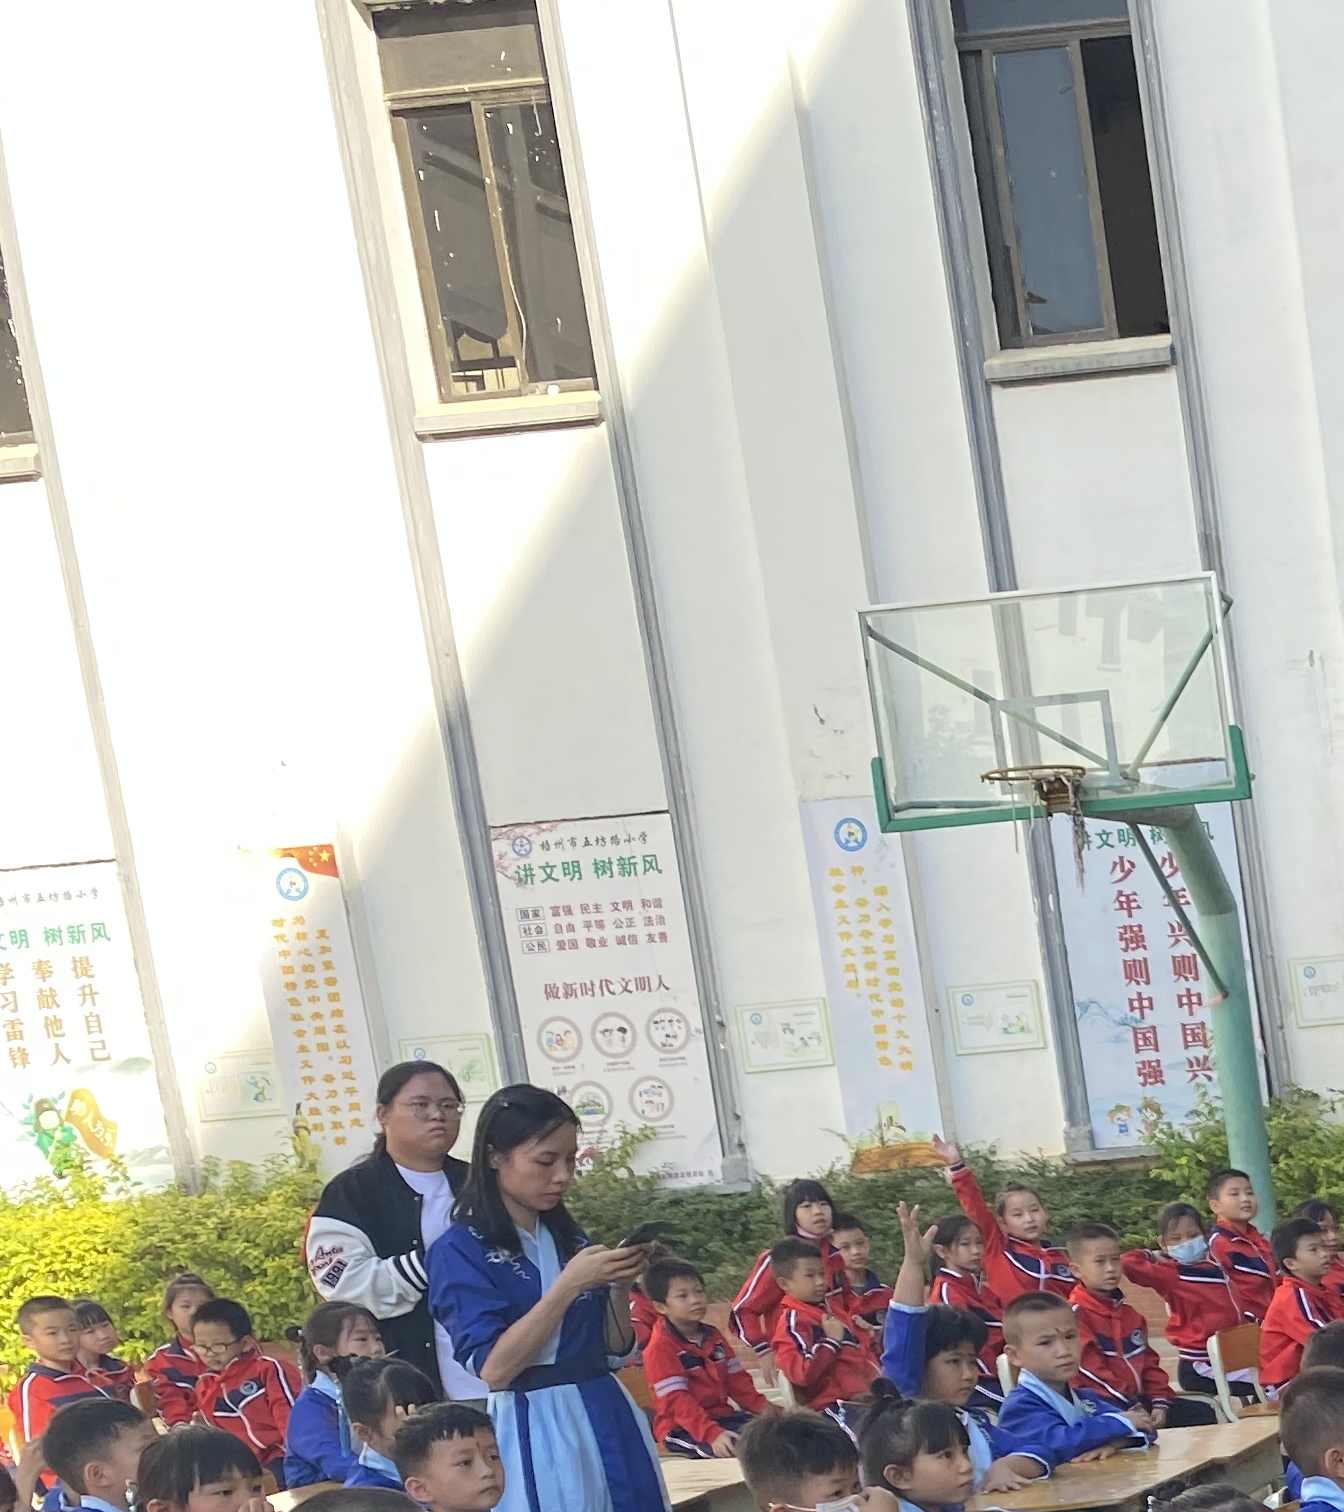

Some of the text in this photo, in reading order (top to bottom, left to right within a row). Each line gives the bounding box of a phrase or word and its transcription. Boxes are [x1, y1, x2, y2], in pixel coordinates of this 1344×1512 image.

[514, 854, 663, 886] 讲文明 树新风
[580, 903, 603, 915] 民主
[610, 900, 633, 913] 文明
[43, 922, 111, 946] 树新风
[522, 925, 544, 936] 社会
[554, 922, 576, 934] 自由
[613, 917, 636, 930] 公正
[526, 941, 547, 952] 公民
[556, 939, 579, 951] 爱国
[585, 937, 608, 949] 敬业
[615, 934, 638, 947] 诚信
[1110, 855, 1165, 1088] 少年强则中国强
[1159, 851, 1215, 1083] 少年兴则中国兴
[544, 975, 670, 1001] 做新时代文明人
[0, 962, 31, 1069] 学习雷锋
[31, 959, 72, 1066] 奉献他人
[71, 956, 112, 1062] 提升自己
[322, 1260, 348, 1289] 1991
